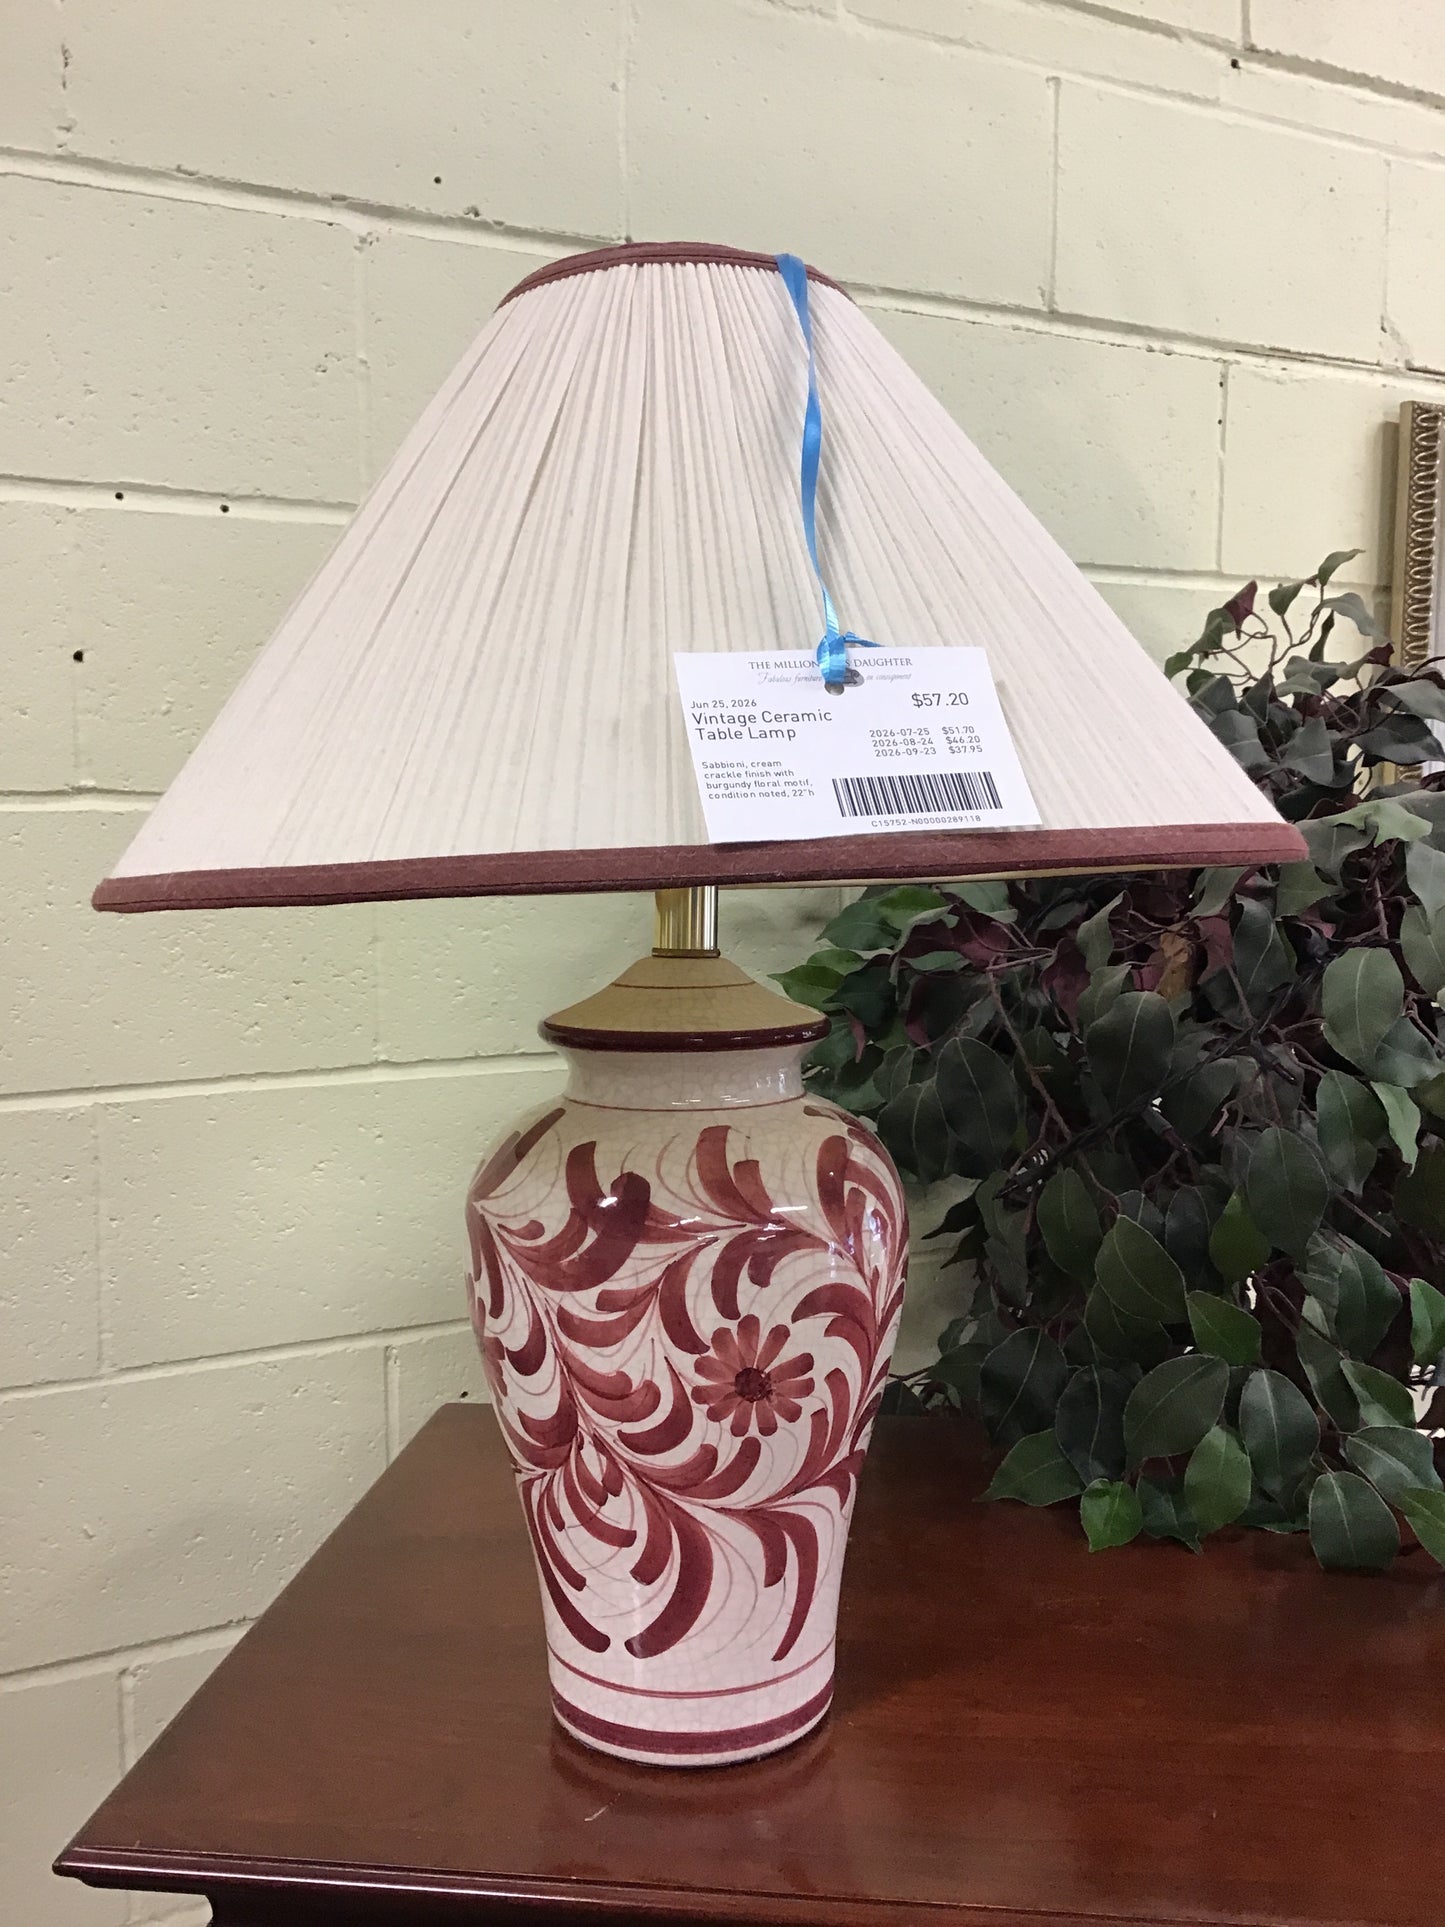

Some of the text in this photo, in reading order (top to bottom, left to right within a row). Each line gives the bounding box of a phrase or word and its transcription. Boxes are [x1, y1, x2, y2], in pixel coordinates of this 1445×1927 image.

[748, 657, 913, 670] THE MILLIONS DAUGHTER
[690, 699, 757, 709] Jun 25, 2026
[911, 692, 969, 708] $57.20
[691, 709, 833, 727] Vintage Ceramic
[695, 727, 797, 741] Table Lamp
[869, 725, 975, 738] 2026-07-25 $51.70
[872, 735, 981, 748] 2026-08-24 $46.20
[875, 744, 983, 758] 2026-09-23 $37.95
[702, 760, 782, 770] Sabbioni, cream
[704, 769, 795, 780] crackle finish with
[706, 779, 813, 791] burgundy floral motif,
[708, 791, 756, 800] condition
[758, 790, 790, 798] noted,
[871, 815, 981, 827] C15752-N00000289118
